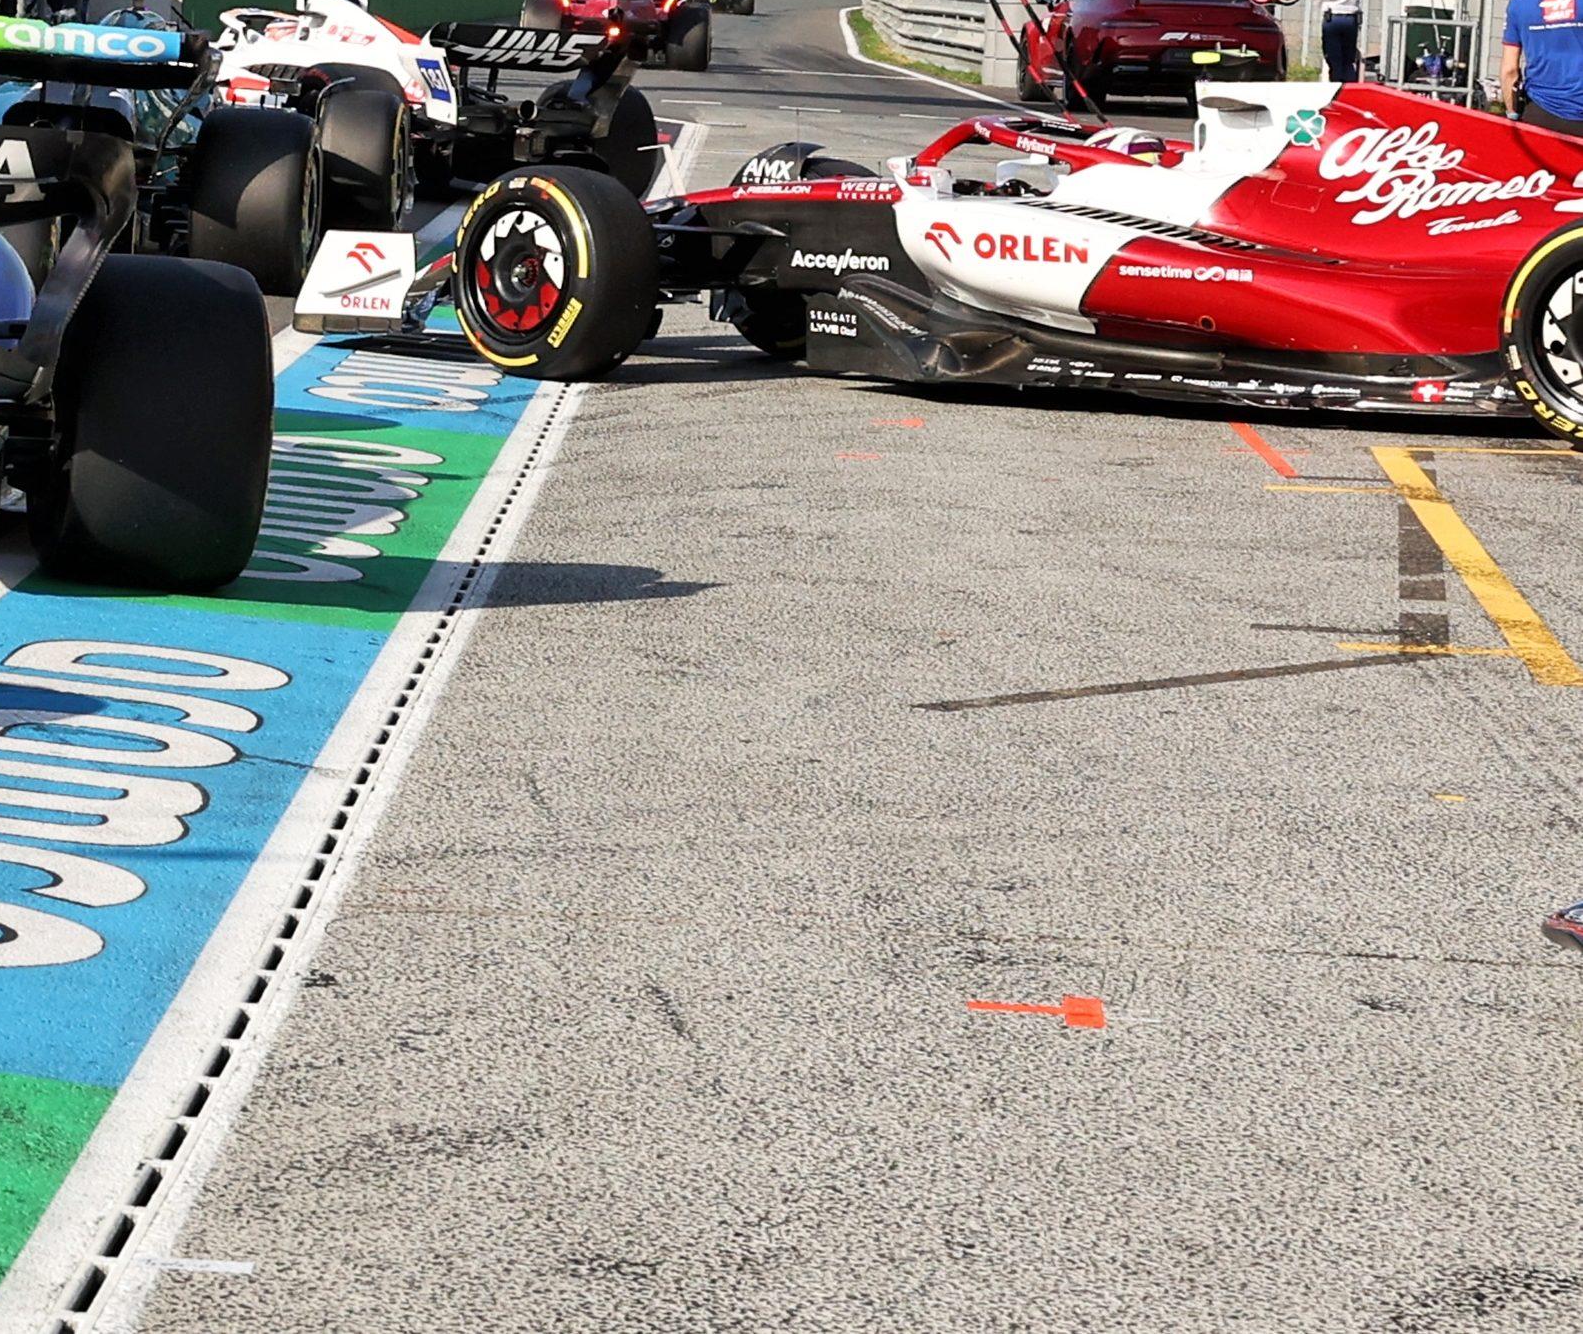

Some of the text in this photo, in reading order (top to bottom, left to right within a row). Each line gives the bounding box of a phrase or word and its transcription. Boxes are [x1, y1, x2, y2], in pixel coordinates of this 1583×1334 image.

[450, 28, 608, 66] HAAS
[742, 157, 795, 181] AMX
[1316, 121, 1466, 204] Alfa
[1350, 168, 1557, 227] Romeo
[456, 182, 501, 247] ZERO
[1424, 208, 1523, 236] Tonale
[973, 231, 1089, 265] ORLEN
[1118, 264, 1193, 279] sensetime
[340, 293, 391, 311] ORLEN
[809, 309, 858, 324] SEAGATE
[809, 321, 840, 335] LYVE
